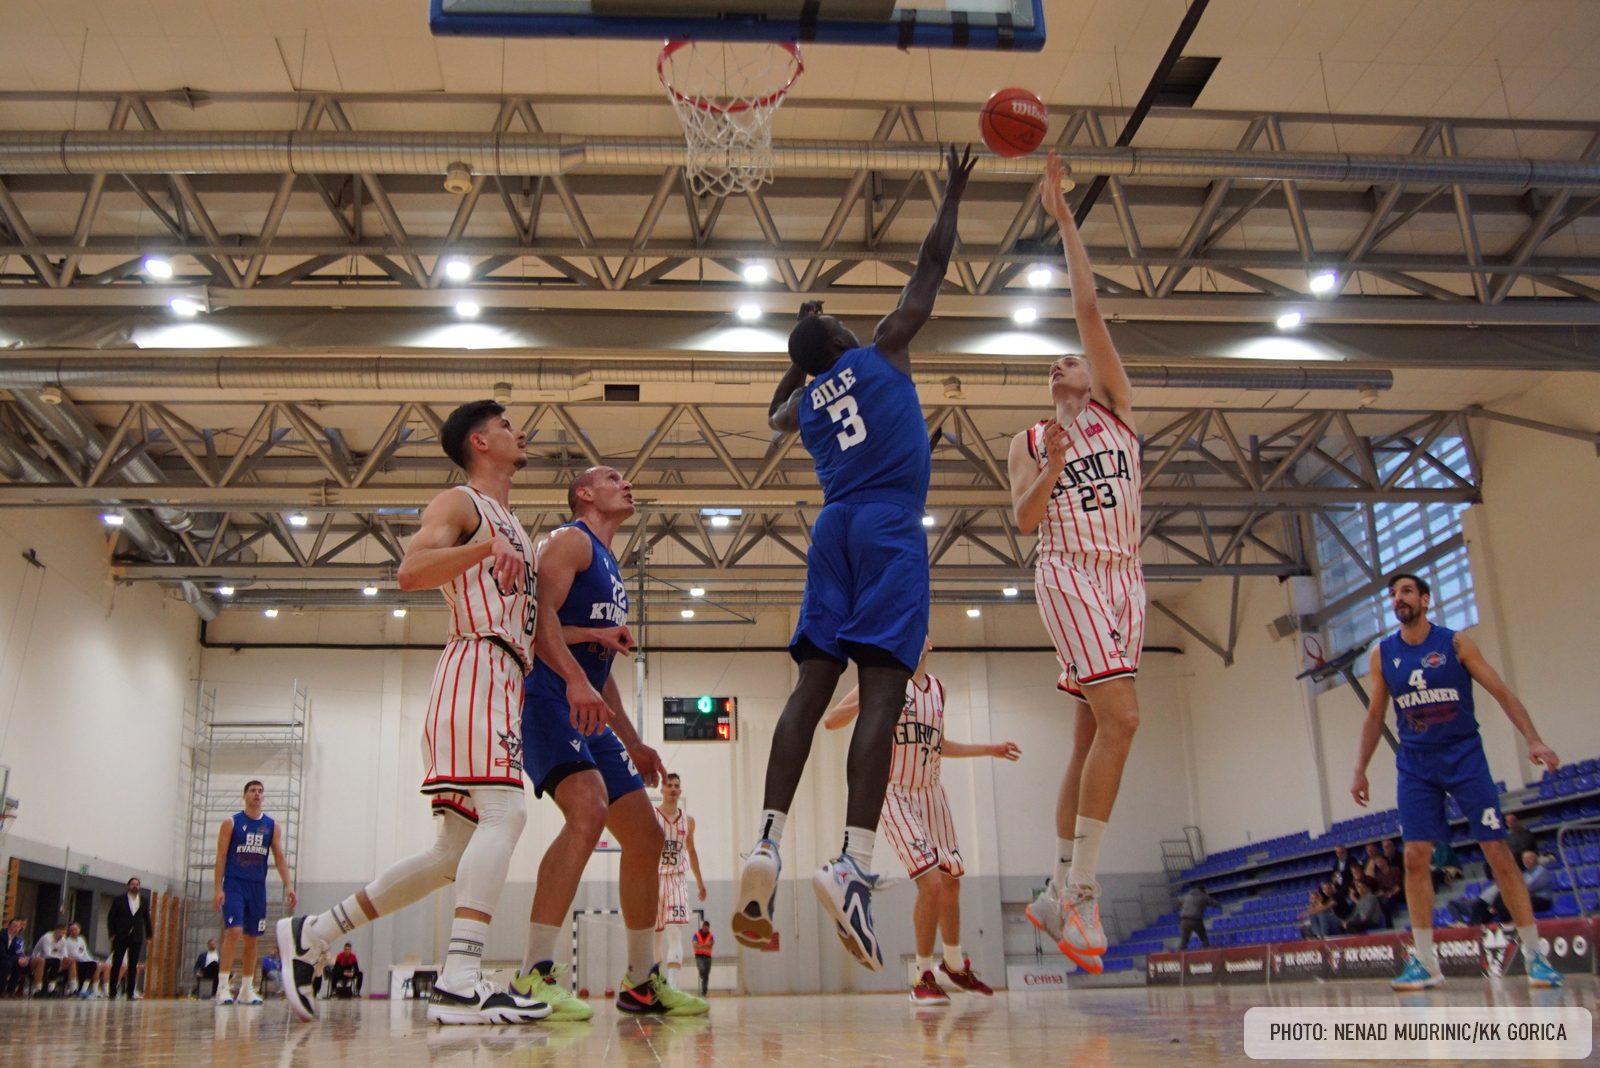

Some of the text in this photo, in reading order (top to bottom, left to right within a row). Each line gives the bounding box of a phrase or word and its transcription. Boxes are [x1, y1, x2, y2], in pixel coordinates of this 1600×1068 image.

[810, 367, 857, 411] BILE
[826, 395, 867, 452] 3
[1078, 483, 1117, 512] 23
[1408, 669, 1427, 690] 4
[921, 747, 929, 767] 7
[1481, 807, 1500, 830] 4
[662, 852, 678, 866] 55
[672, 906, 686, 917] 55
